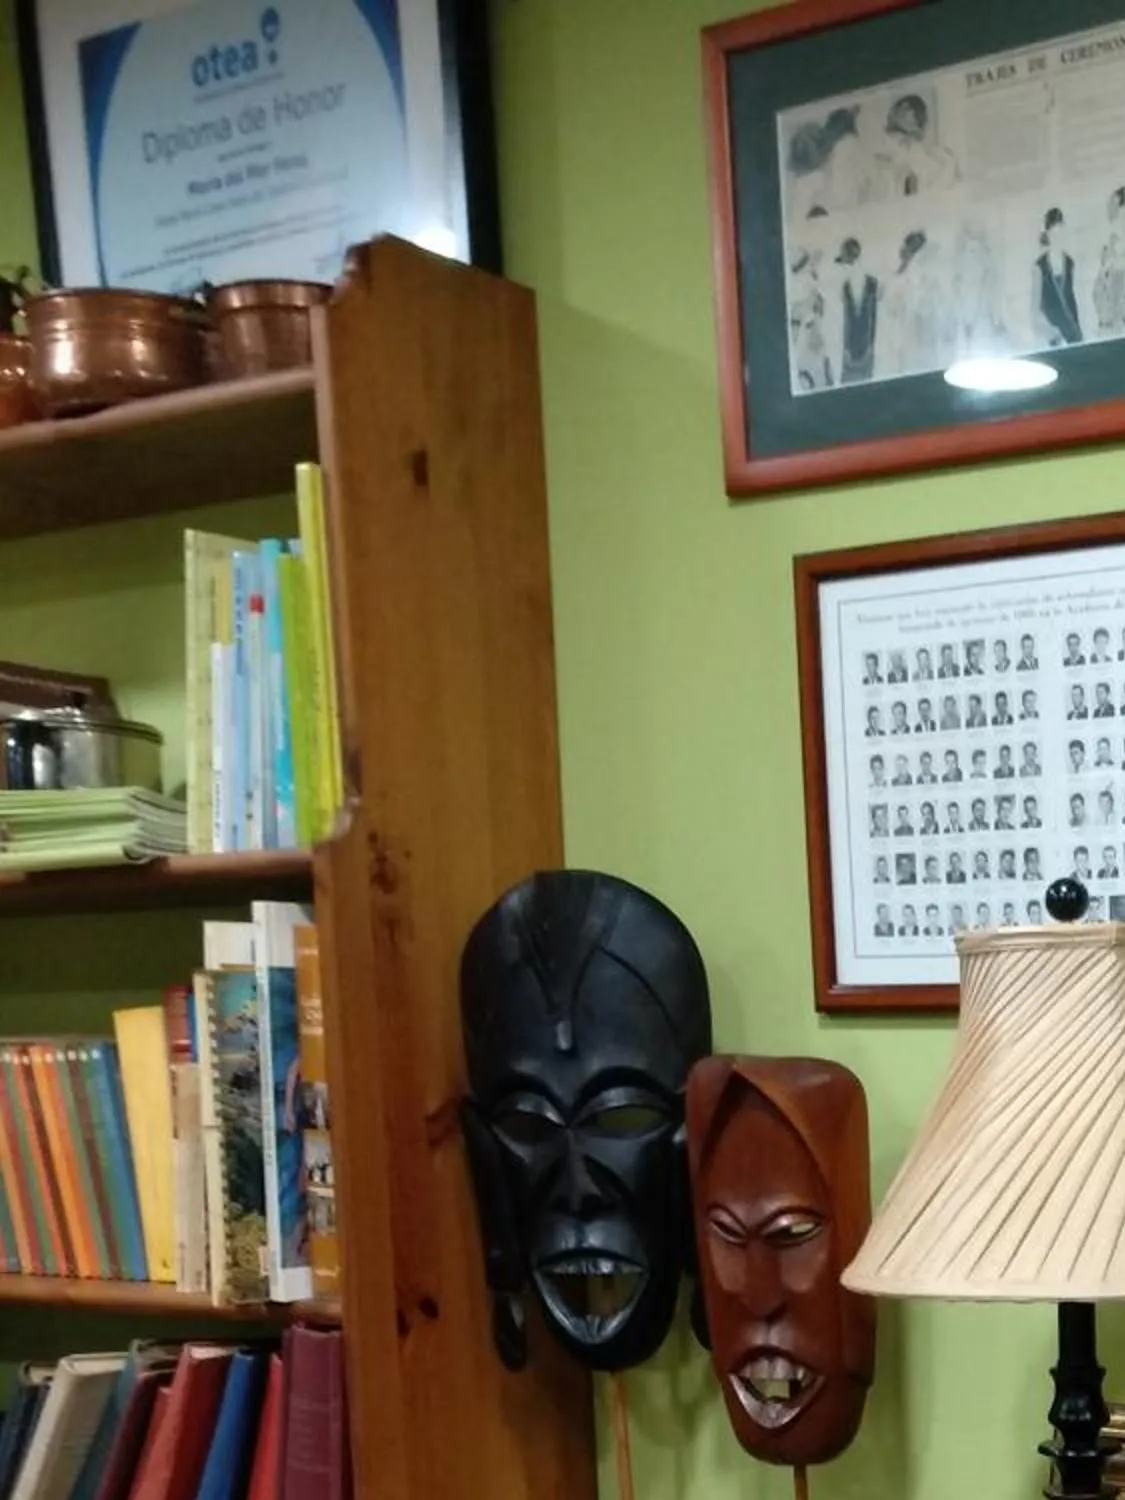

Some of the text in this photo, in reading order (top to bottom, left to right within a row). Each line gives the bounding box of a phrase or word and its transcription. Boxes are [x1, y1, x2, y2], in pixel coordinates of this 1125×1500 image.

[192, 41, 258, 87] otea
[142, 116, 233, 166] Diploma
[238, 106, 267, 135] de
[272, 83, 347, 126] Honor
